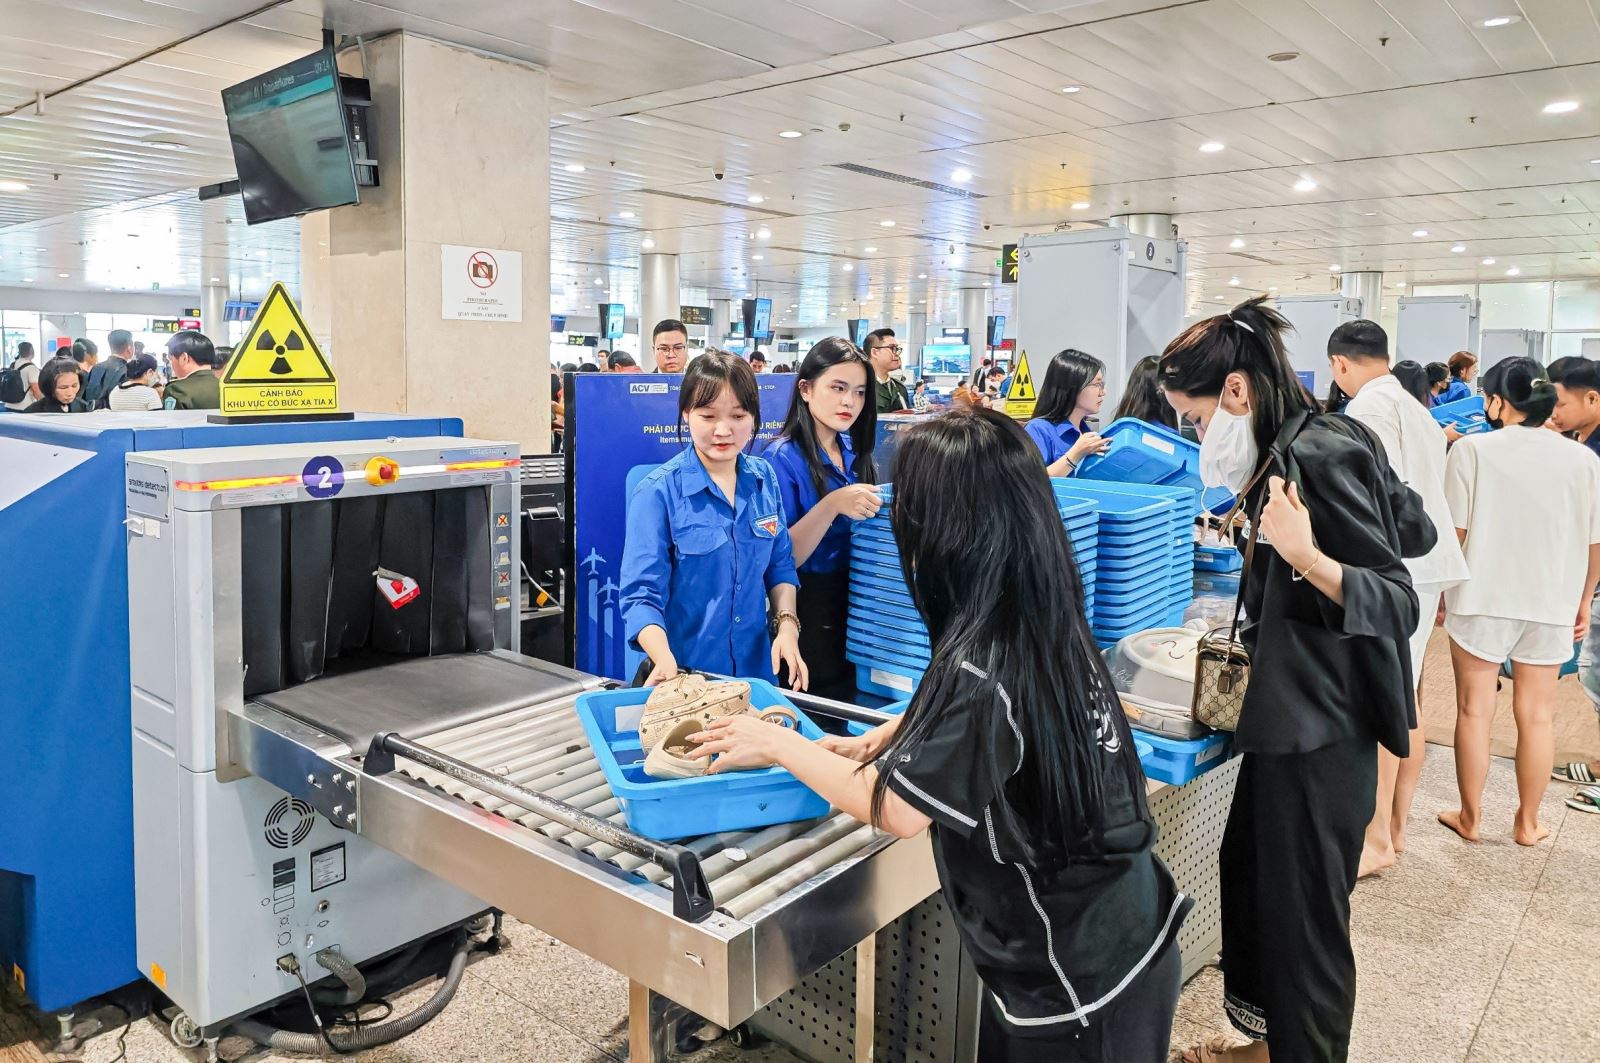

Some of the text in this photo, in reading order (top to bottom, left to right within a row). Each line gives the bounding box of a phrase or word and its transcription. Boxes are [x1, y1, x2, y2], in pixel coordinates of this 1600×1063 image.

[167, 322, 179, 332] 18
[632, 384, 650, 392] ACV
[227, 400, 245, 408] KHU
[643, 423, 663, 434] PHẢI
[660, 435, 680, 444] Items
[317, 466, 332, 489] 2
